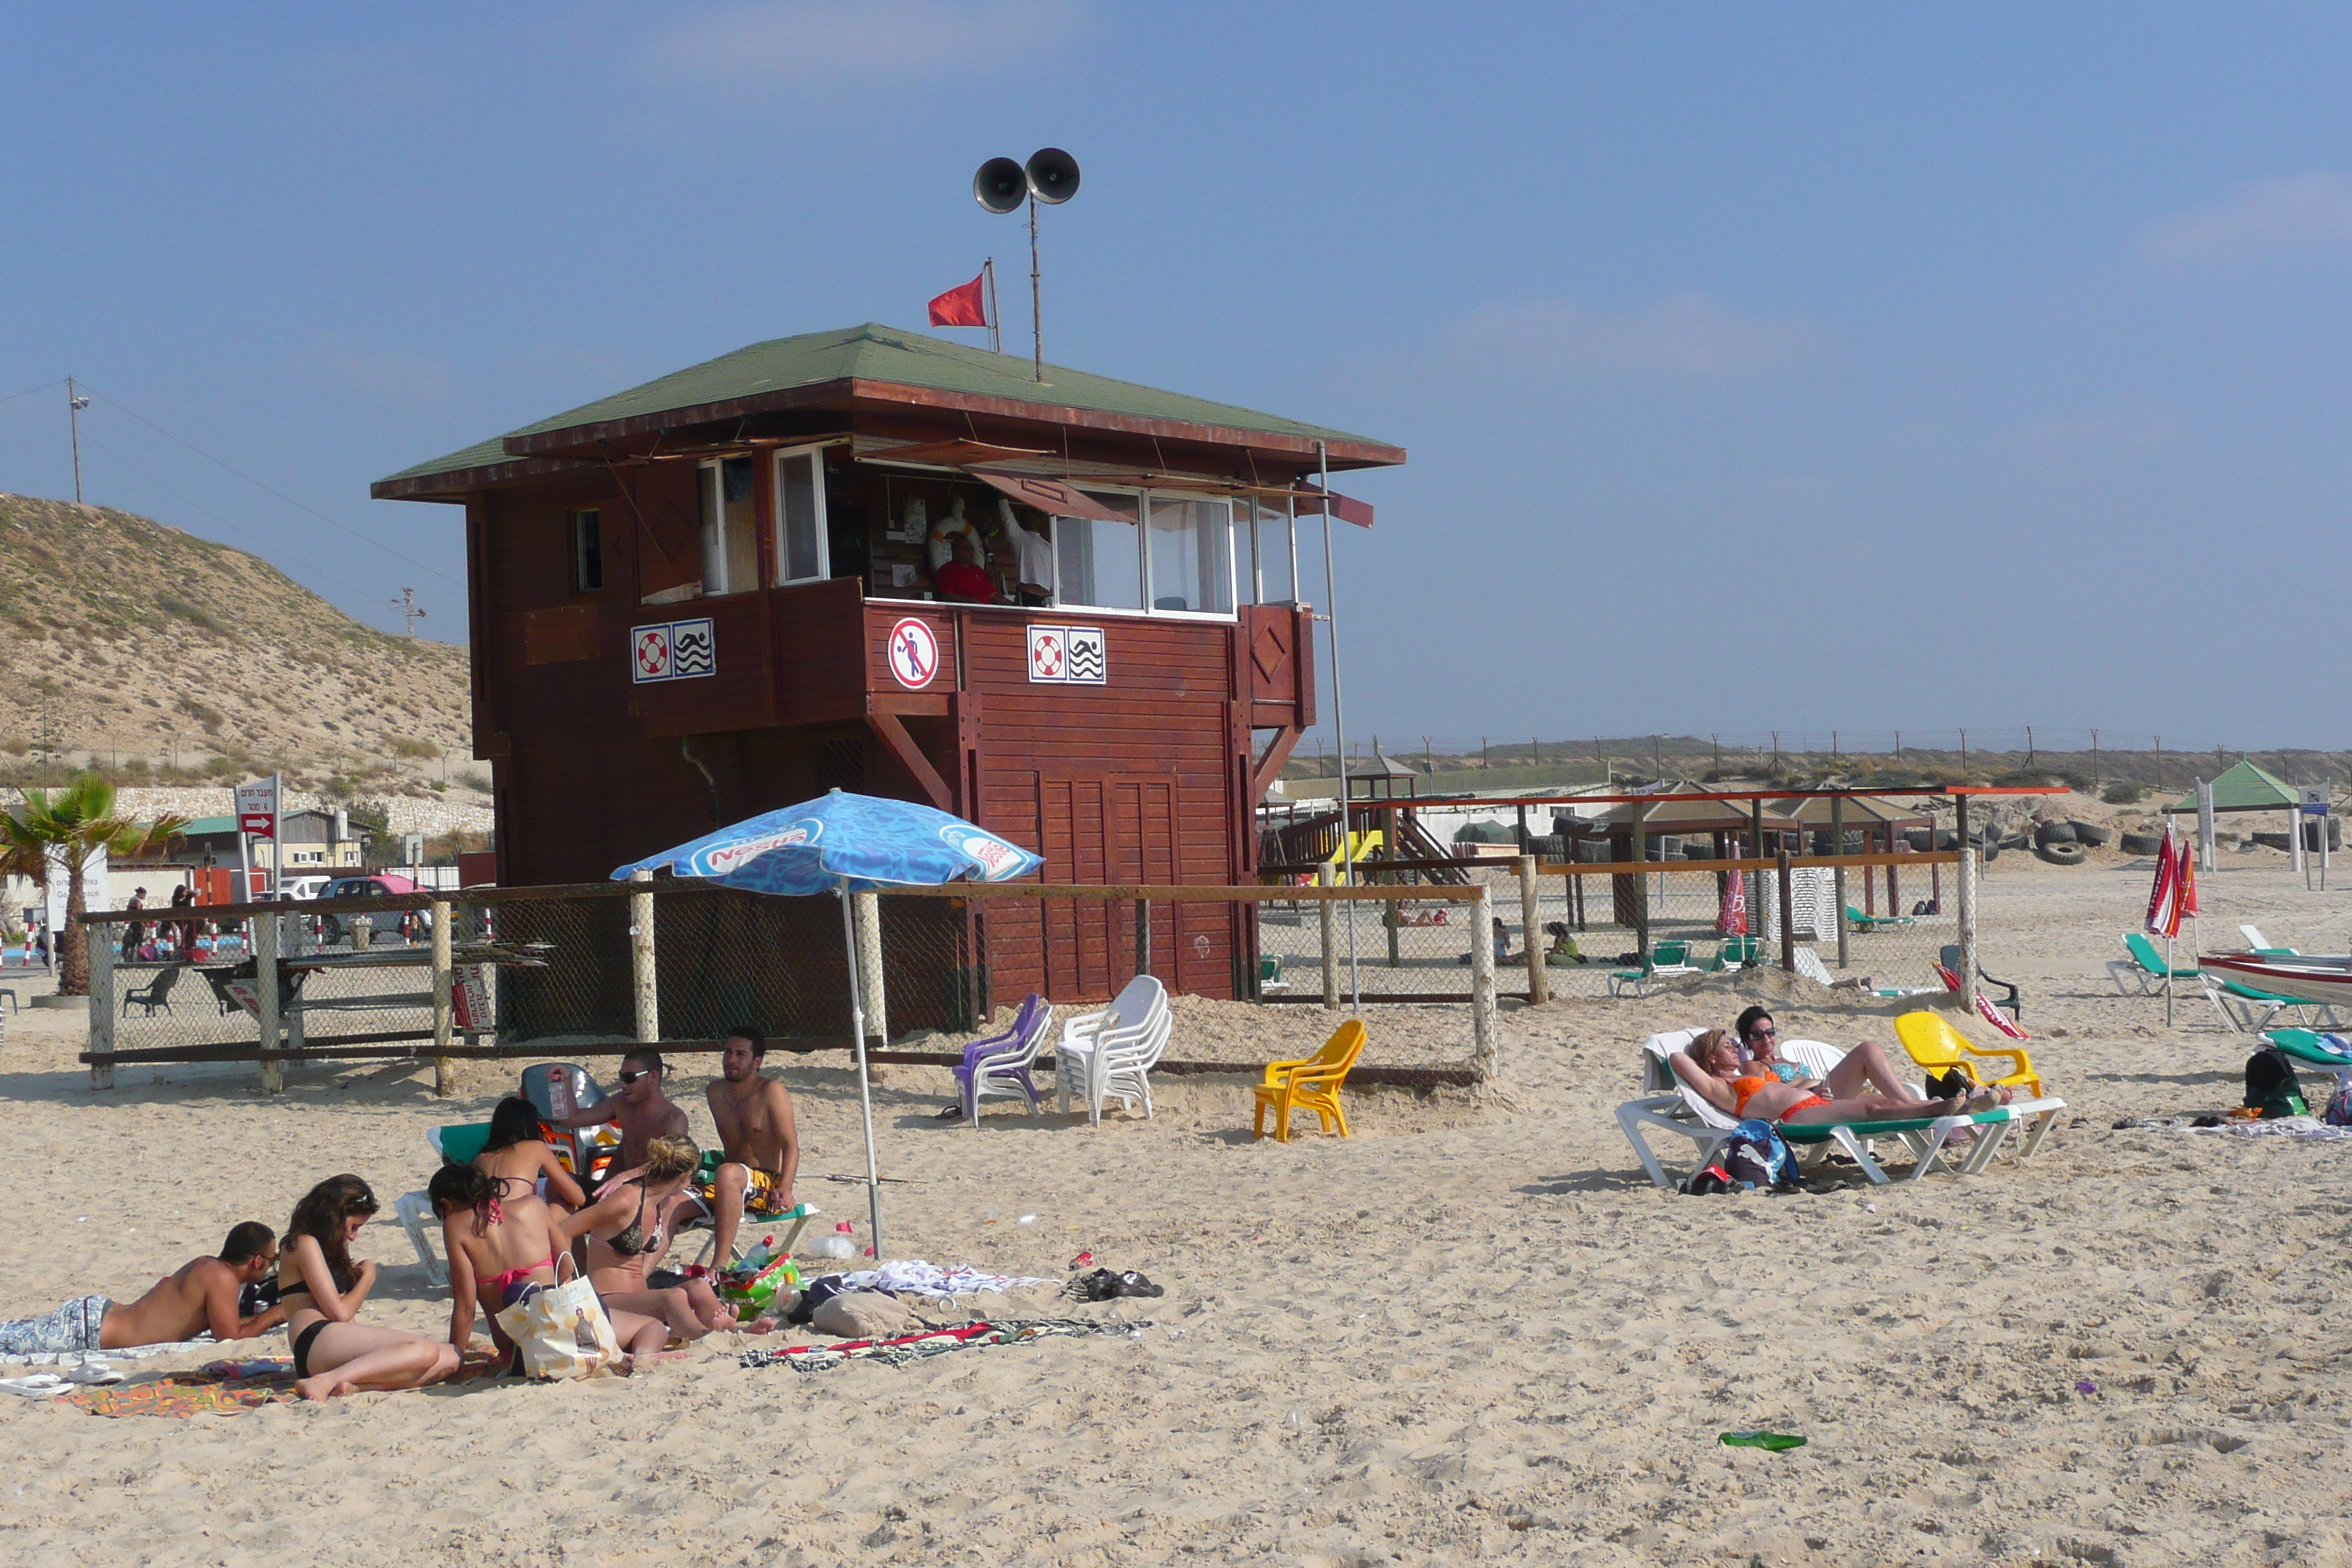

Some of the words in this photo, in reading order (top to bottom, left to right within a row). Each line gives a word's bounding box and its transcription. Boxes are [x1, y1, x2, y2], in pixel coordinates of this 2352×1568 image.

[241, 789, 255, 797] חרום
[256, 788, 274, 797] מעבר
[247, 802, 260, 811] מטר
[263, 802, 268, 811] 6
